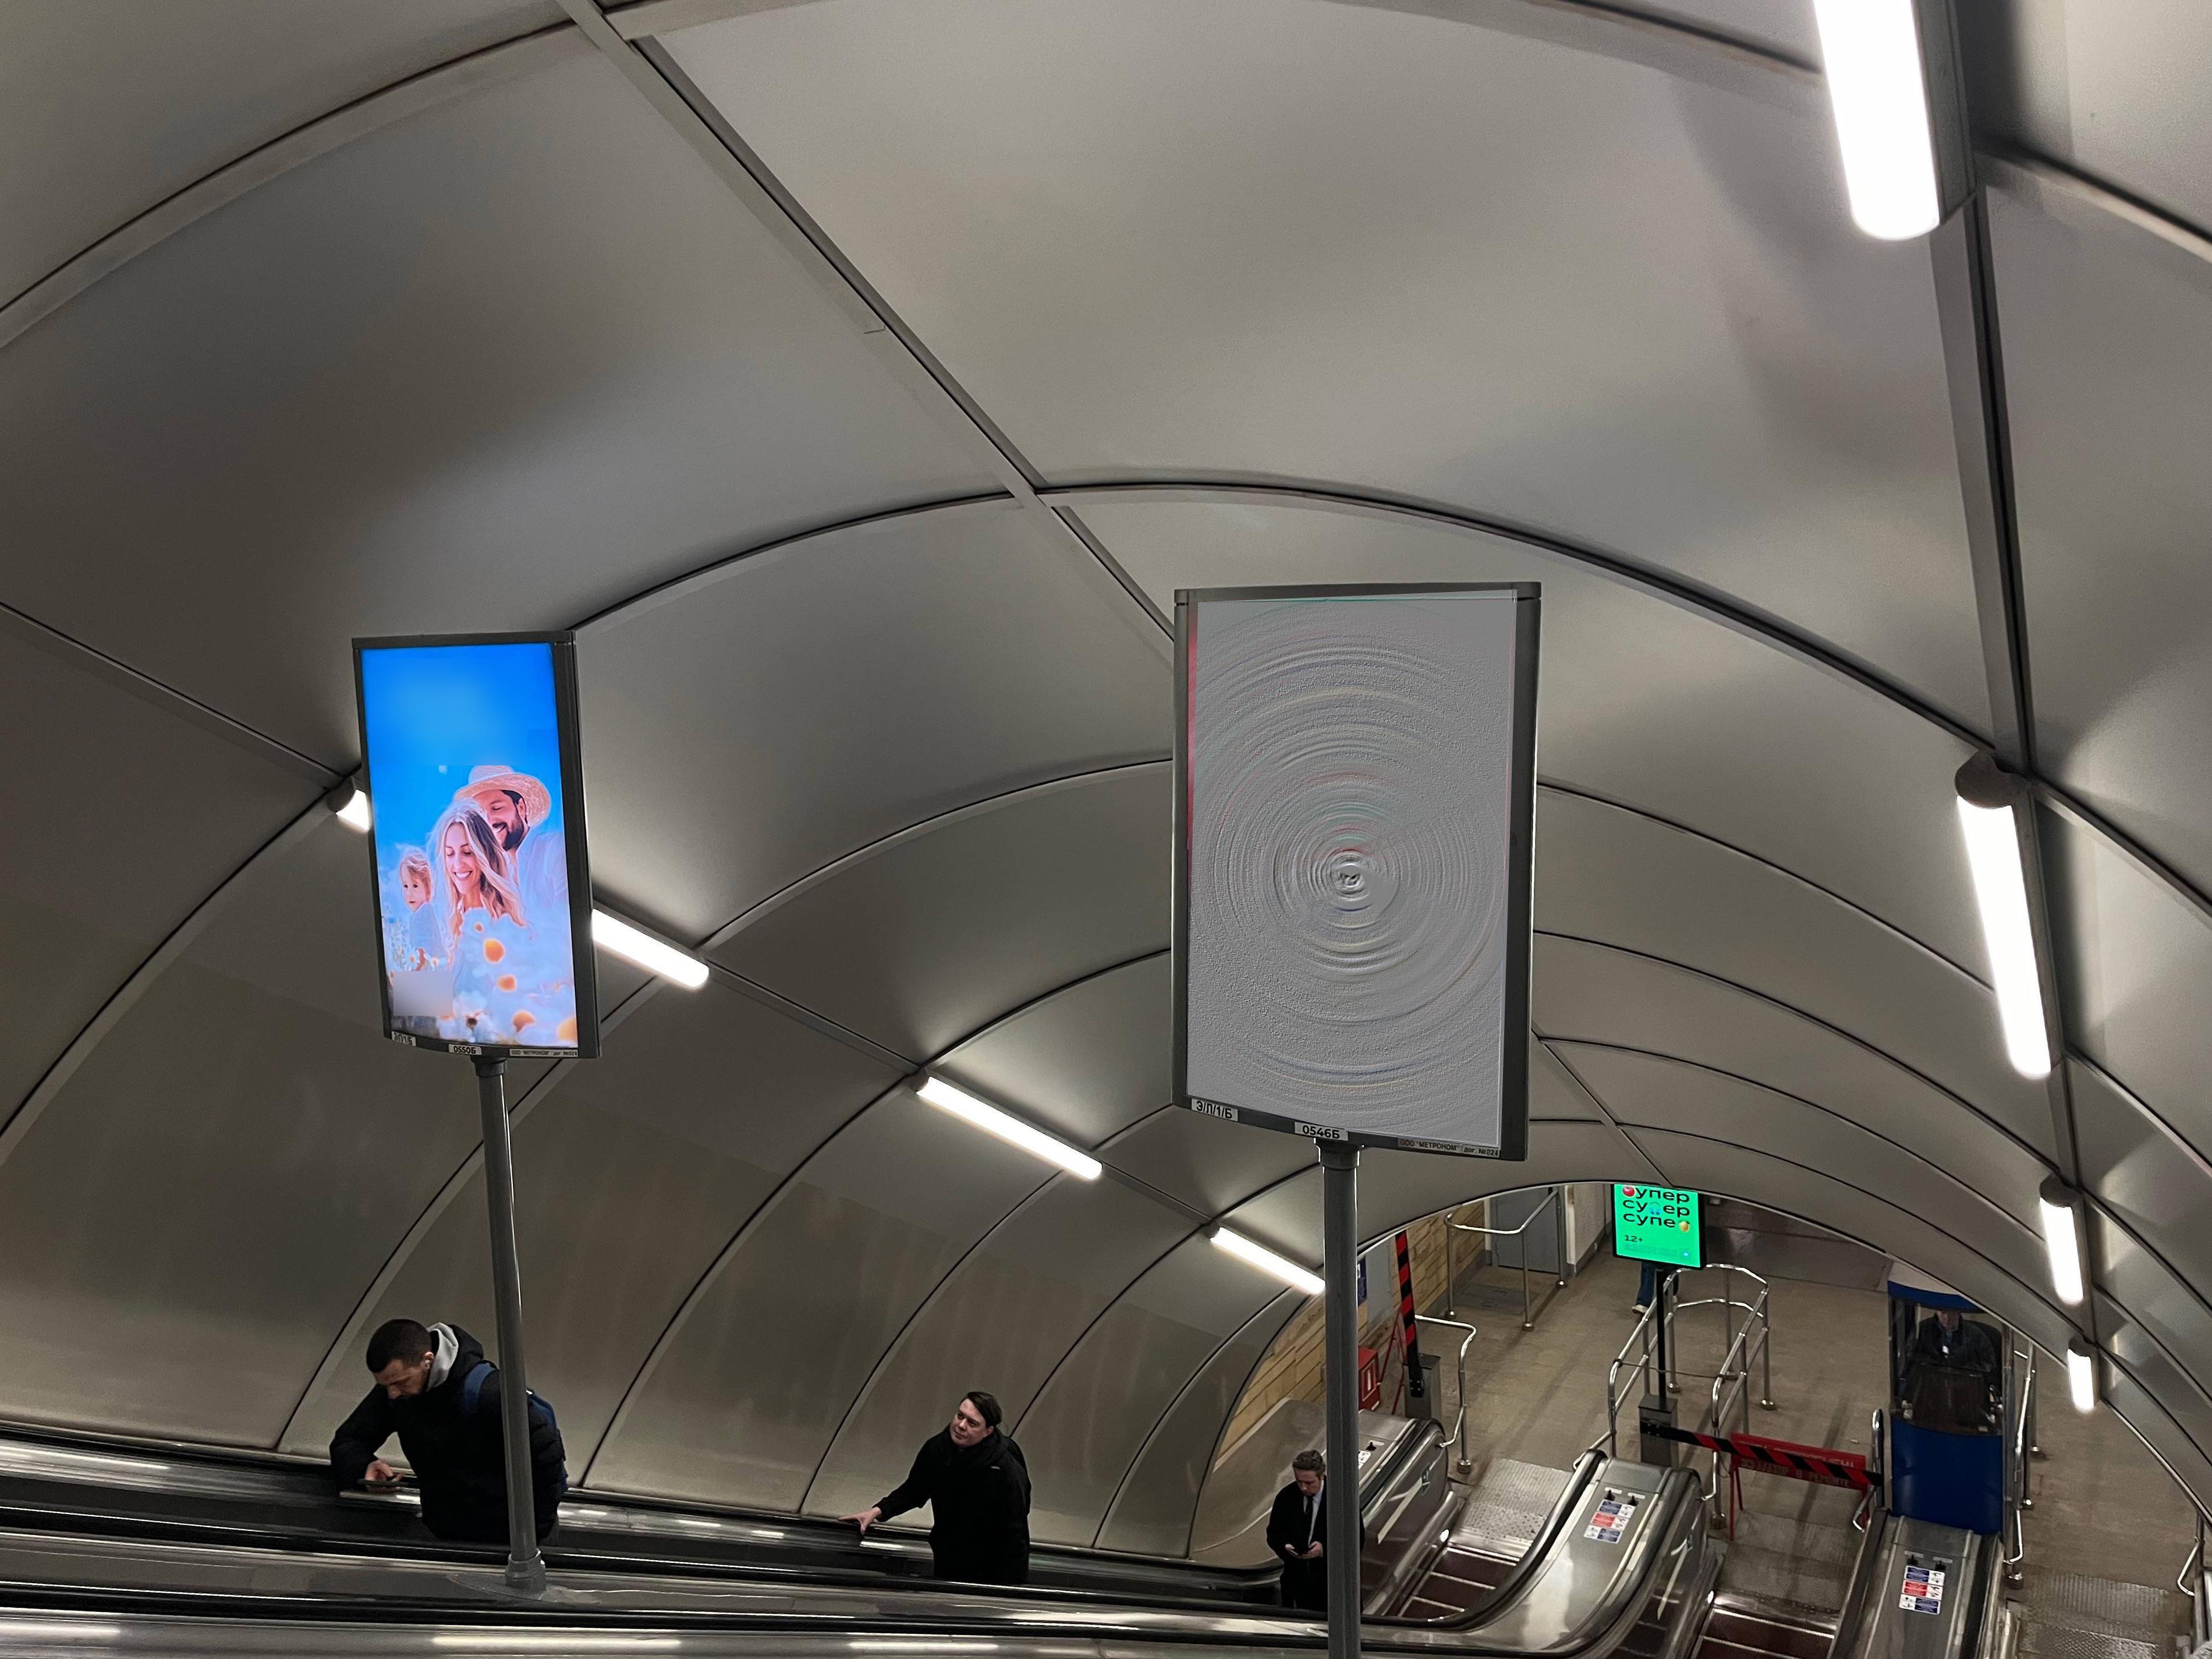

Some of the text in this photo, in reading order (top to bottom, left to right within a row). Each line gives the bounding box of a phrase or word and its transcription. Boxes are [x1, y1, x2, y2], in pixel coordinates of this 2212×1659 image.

[1302, 1125, 1340, 1139] 0546Б
[1623, 1186, 1690, 1204] упер
[1623, 1200, 1690, 1218] суер
[1623, 1213, 1690, 1230] супе
[1625, 1235, 1643, 1243] 12+
